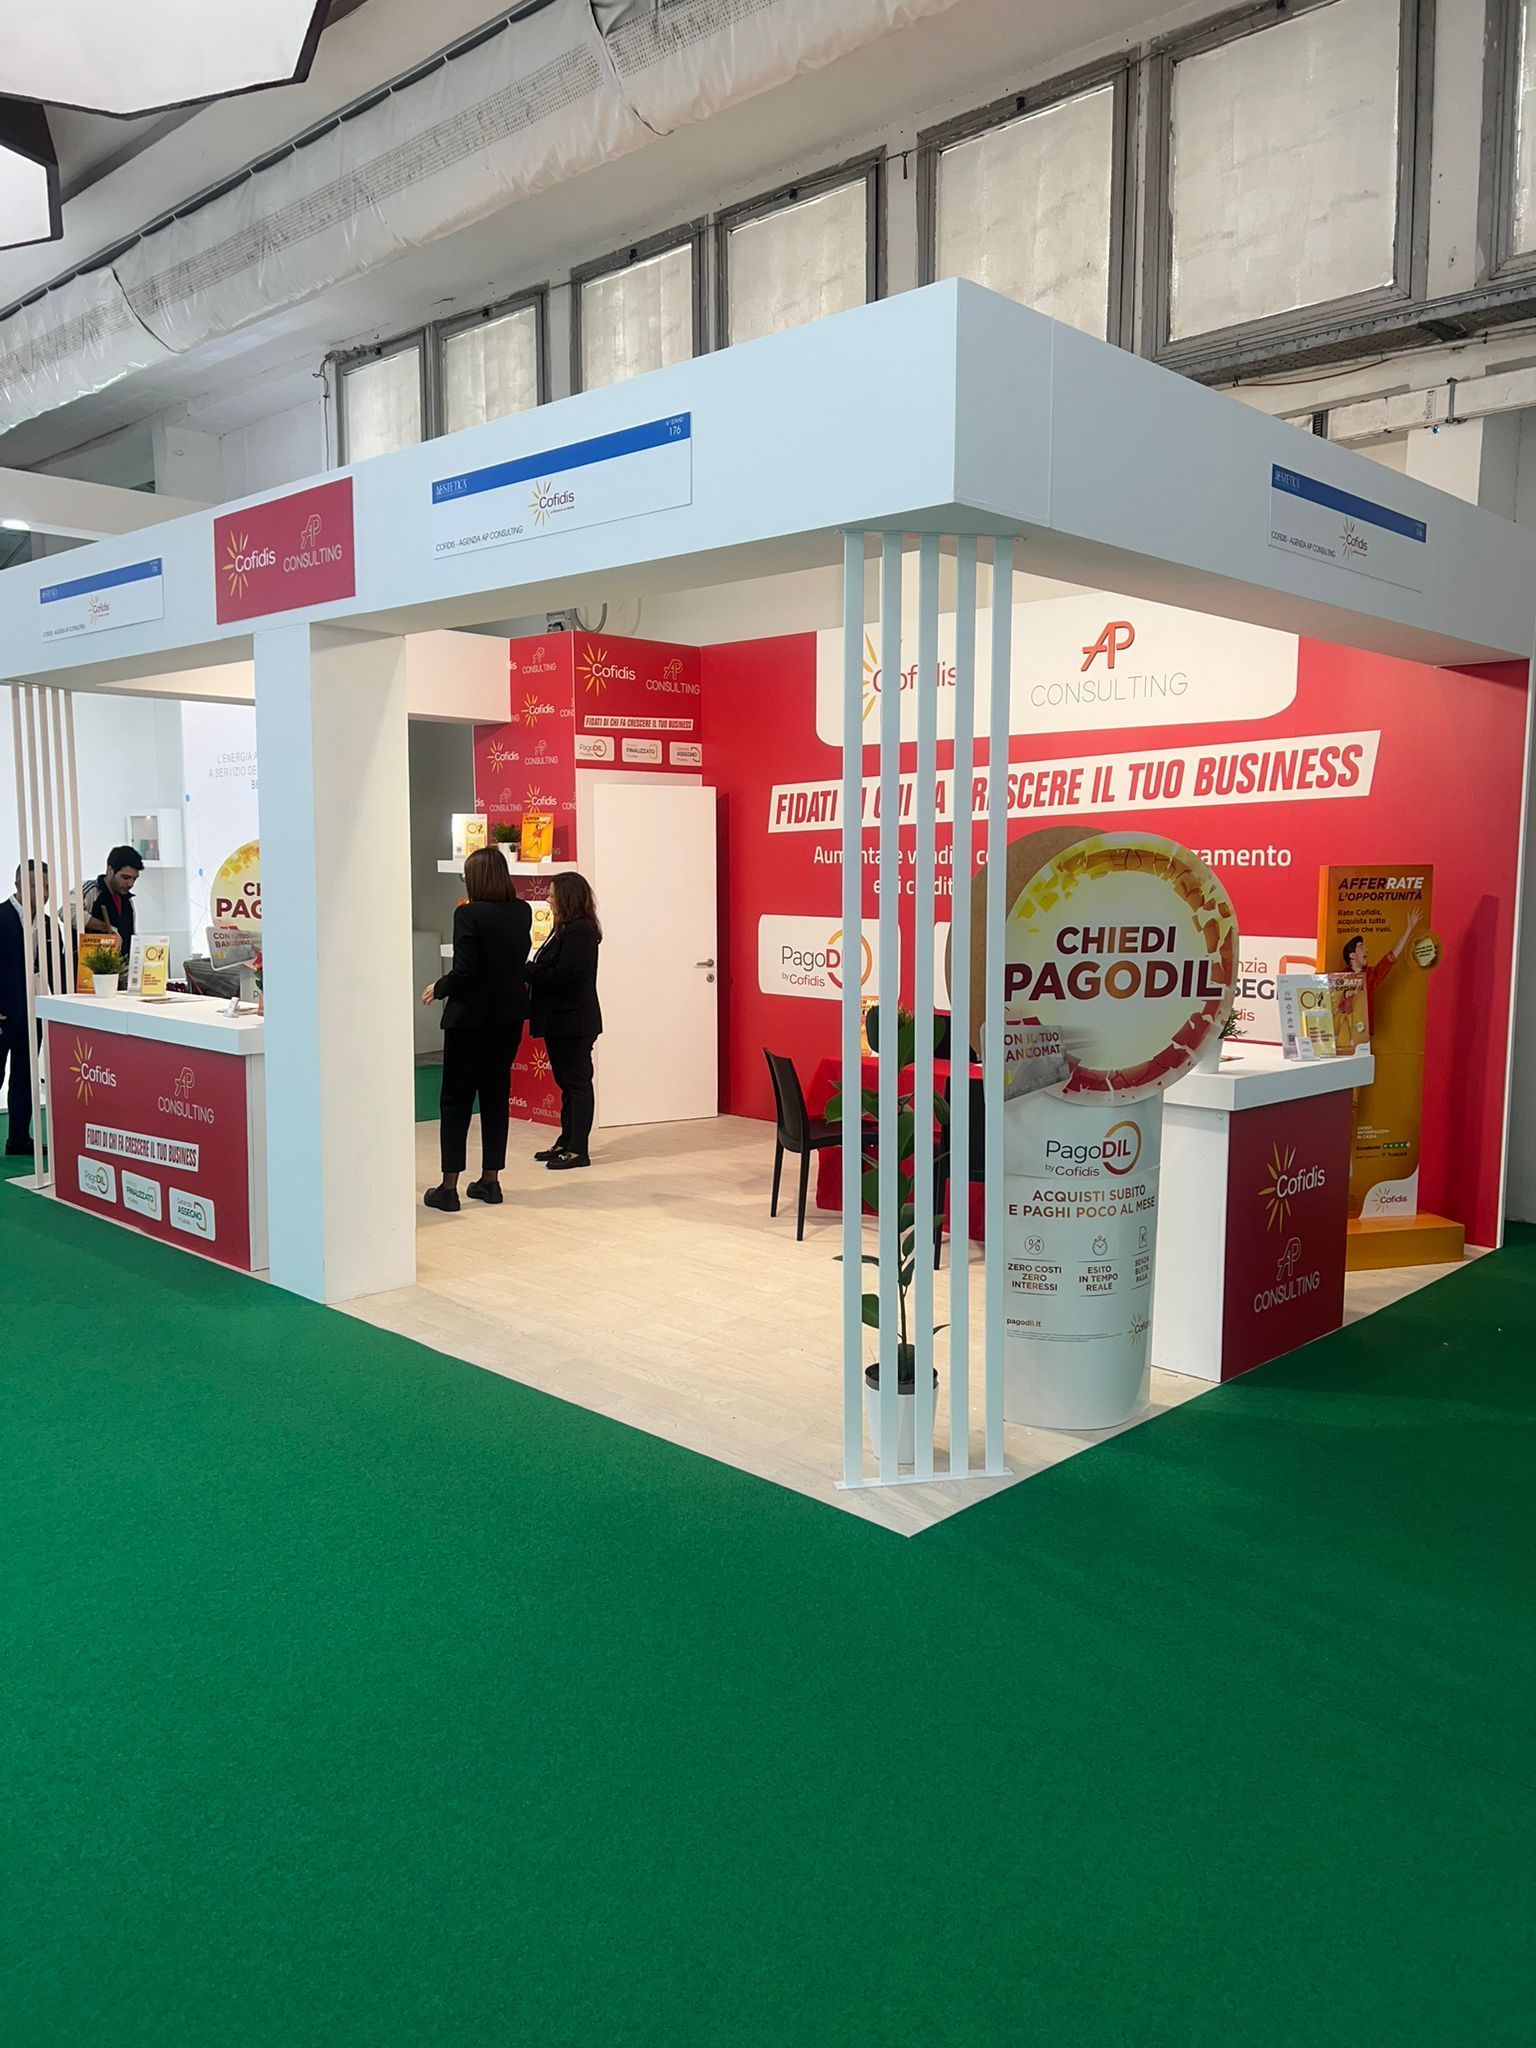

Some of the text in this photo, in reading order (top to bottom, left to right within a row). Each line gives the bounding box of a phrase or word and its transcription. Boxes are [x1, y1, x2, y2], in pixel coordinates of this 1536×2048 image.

[669, 425, 681, 436] 176
[539, 491, 575, 509] Cofidis
[300, 513, 322, 549] AP
[436, 525, 524, 552] COFIDIS AGENZIA AP CONSULTING
[1346, 534, 1368, 551] Cofidis
[235, 544, 342, 573] Cofidis CONSULTING
[1081, 620, 1136, 673] AP
[522, 662, 557, 674] CONSULTING
[592, 663, 636, 681] Cofidis
[663, 658, 683, 681] AP
[646, 679, 700, 695] CONSULTING
[1030, 672, 1189, 707] CONSULTING
[529, 703, 555, 715] Cofidis
[586, 717, 602, 726] FIDATI
[603, 718, 609, 726] DI
[610, 718, 618, 727] CHI
[620, 718, 627, 727] FA
[627, 719, 652, 728] CRESCERE
[658, 720, 667, 728] TUO
[668, 720, 692, 729] BUSINESS
[494, 750, 558, 766] Cofidis CONSULTING
[626, 747, 655, 755] FINALIZZATO
[214, 765, 247, 778] SERVIZIO
[775, 789, 838, 825] FIDATI
[1091, 766, 1115, 804] IL
[1129, 759, 1186, 801] TUO
[1193, 744, 1363, 797] BUSINESS
[489, 803, 522, 812] CONSULTING
[531, 795, 557, 806] Cofidis
[1337, 876, 1425, 890] AFFERRATE
[1337, 889, 1423, 902] L'OPPORTUNITÀ
[1337, 909, 1354, 917] Rate
[1337, 917, 1386, 926] acquista tutto
[1056, 926, 1176, 955] CHIEDI
[782, 971, 826, 988] by Cofidis
[1004, 959, 1223, 1002] PAGODIL
[1004, 1033, 1023, 1046] ON
[1040, 1031, 1060, 1042] TUO
[1005, 1043, 1061, 1063] ANCOMAT
[80, 1062, 117, 1087] Cofidis
[157, 1096, 215, 1124] CONSULTING
[87, 1128, 197, 1167] FIDATI DI CHI FA CRESCERE IL TUO BUSINESS
[1046, 1139, 1131, 1164] PagoDIL
[1055, 1166, 1100, 1177] Cofidis
[1276, 1164, 1326, 1199] Cofidis
[126, 1185, 154, 1203] FINALIZZATO
[1032, 1184, 1146, 1203] ACQUISTI SUBITO
[1380, 1194, 1408, 1204] Cofidis
[177, 1205, 203, 1221] ASSEGNO
[1009, 1195, 1156, 1218] E PAGHI POCO AL MESE
[1276, 1236, 1302, 1281] AP
[1007, 1263, 1062, 1274] ZERO COSTI
[1022, 1272, 1048, 1282] ZERO
[1087, 1265, 1112, 1274] ESITO
[1011, 1281, 1058, 1291] INTERESSI
[1078, 1273, 1119, 1283] IN TEMPO
[1086, 1282, 1113, 1292] REALE
[1253, 1270, 1321, 1314] CONSULTING
[1006, 1318, 1042, 1328] pagodil.it
